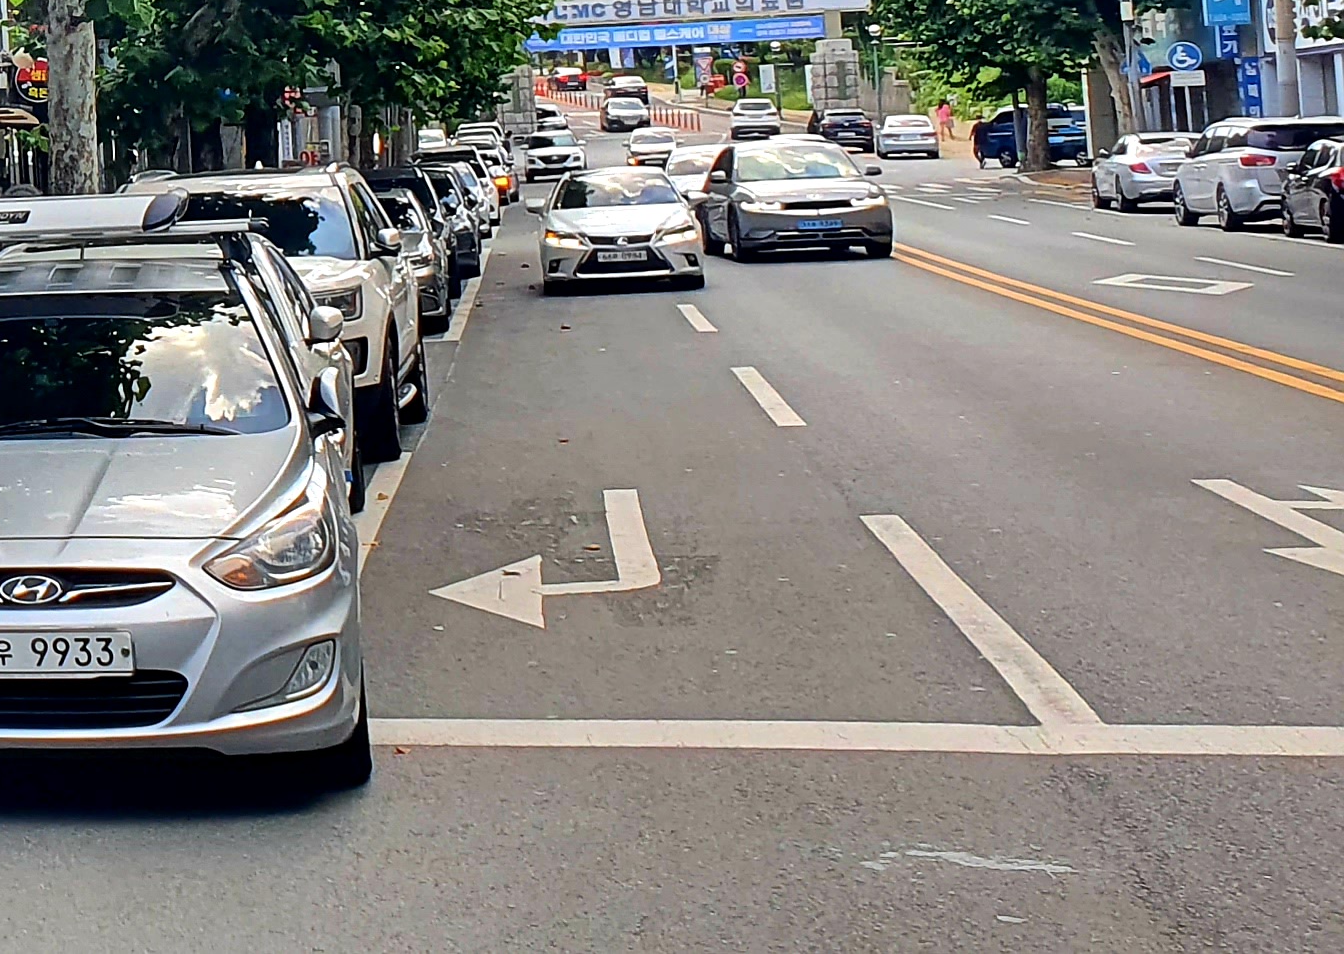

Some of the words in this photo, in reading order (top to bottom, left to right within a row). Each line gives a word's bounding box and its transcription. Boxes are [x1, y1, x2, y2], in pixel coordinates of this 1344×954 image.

[542, 2, 606, 20] UMC
[562, 30, 611, 45] 대한민국
[654, 26, 705, 41] 헬스케어
[30, 637, 115, 667] 9933
